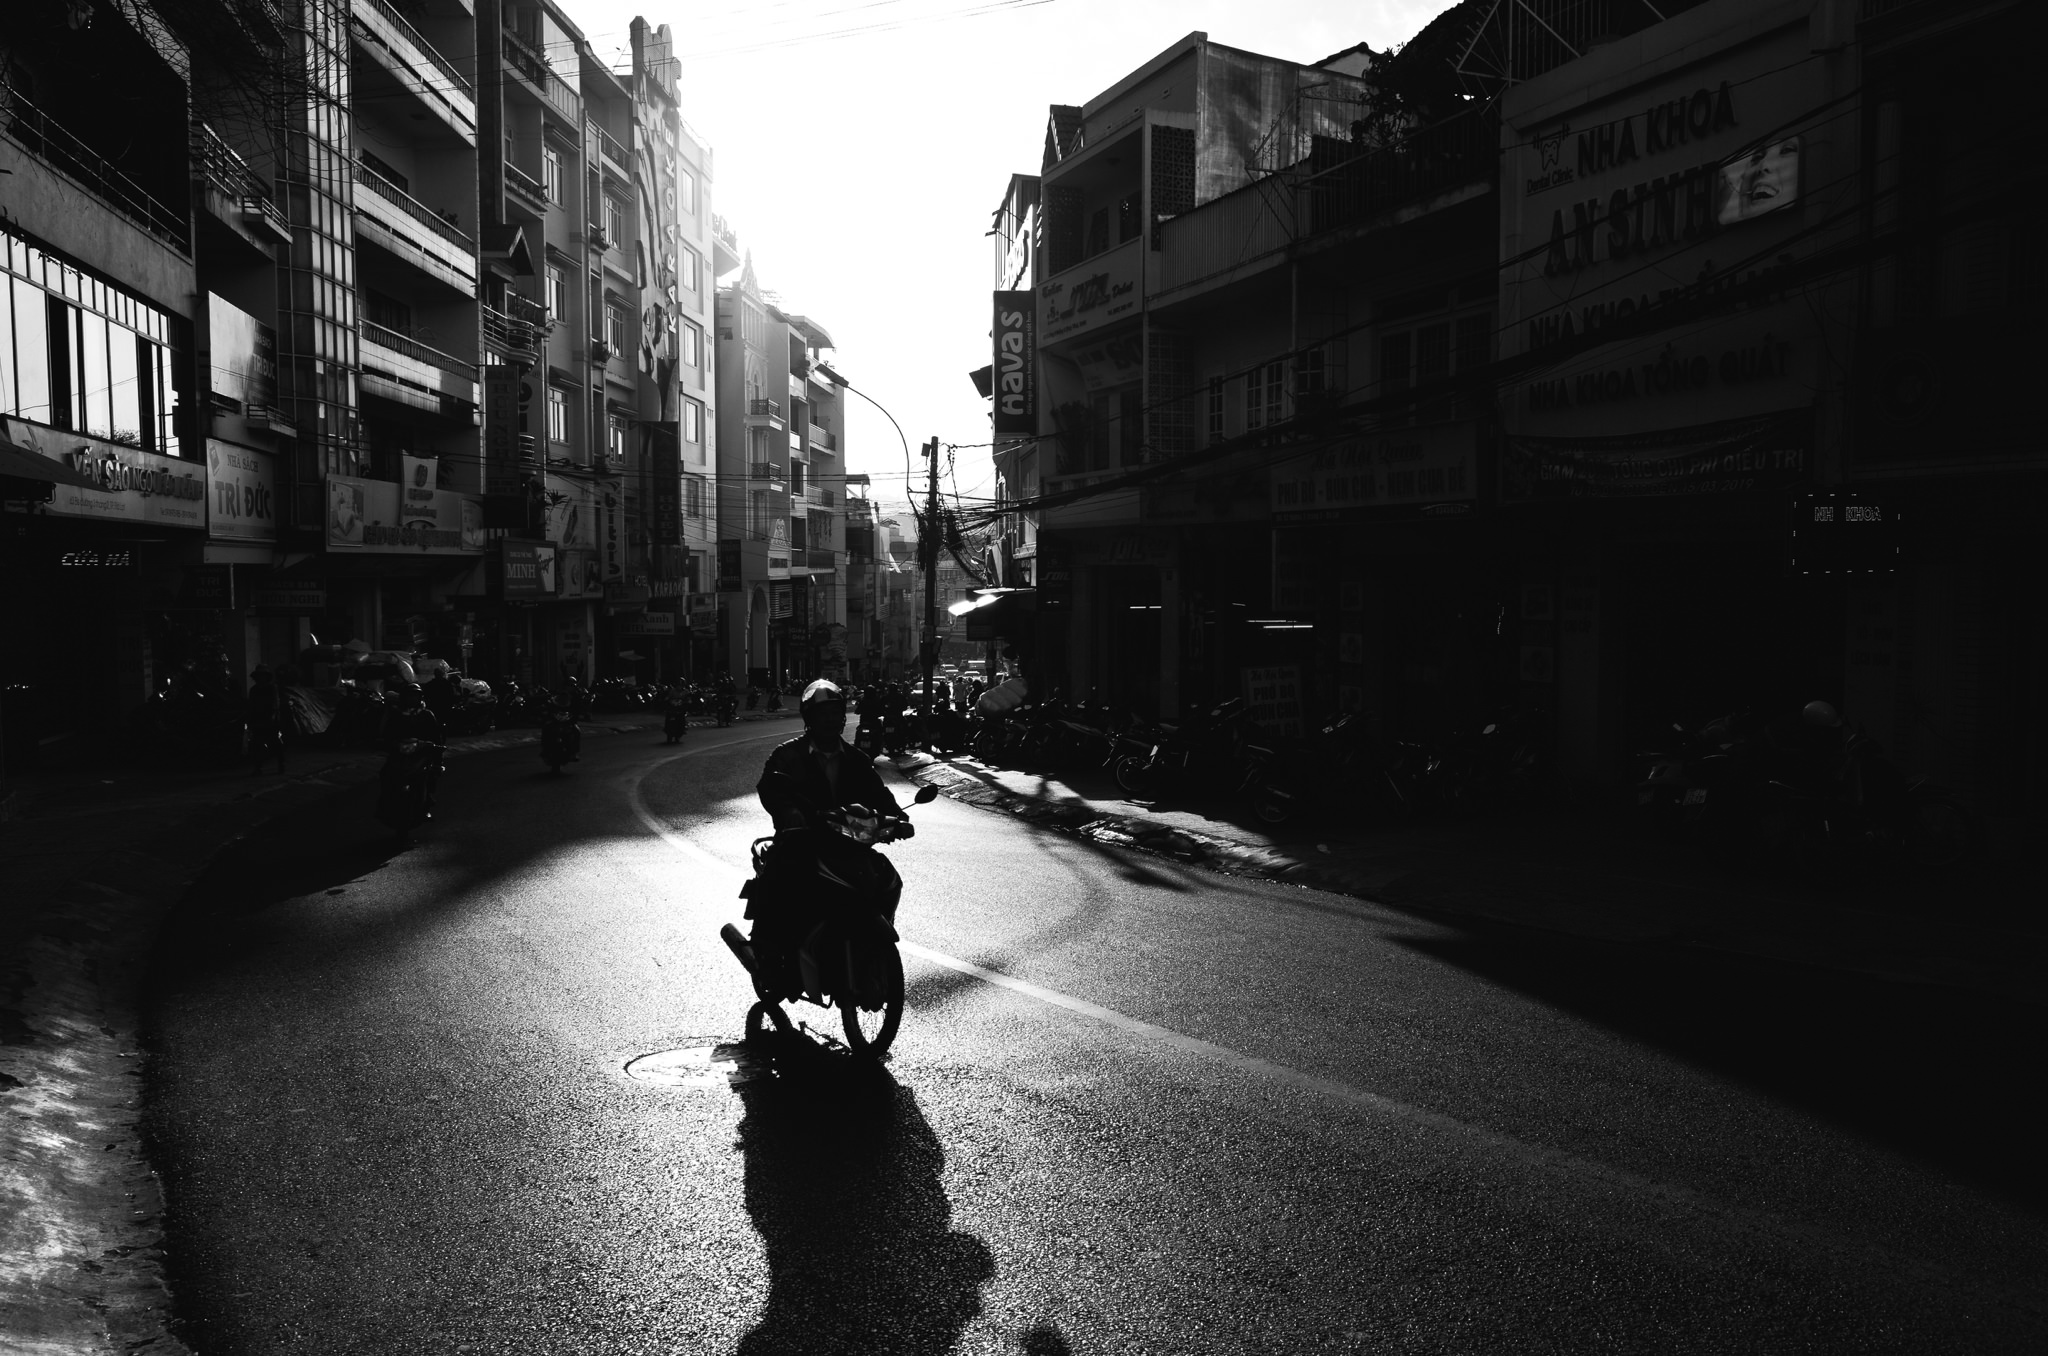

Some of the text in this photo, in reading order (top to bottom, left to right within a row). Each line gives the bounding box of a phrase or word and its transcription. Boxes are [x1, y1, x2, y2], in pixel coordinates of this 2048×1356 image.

[1578, 81, 1738, 178] NHA KHOA
[1526, 167, 1574, 194] Dental Clinic
[1544, 160, 1720, 275] AN SINH
[1529, 378, 1570, 412] NHA
[1576, 368, 1640, 404] KHOA
[227, 454, 242, 469] NHÀ
[215, 476, 241, 520] TRÍ
[244, 481, 271, 521] ĐỨC
[506, 563, 536, 579] MINH
